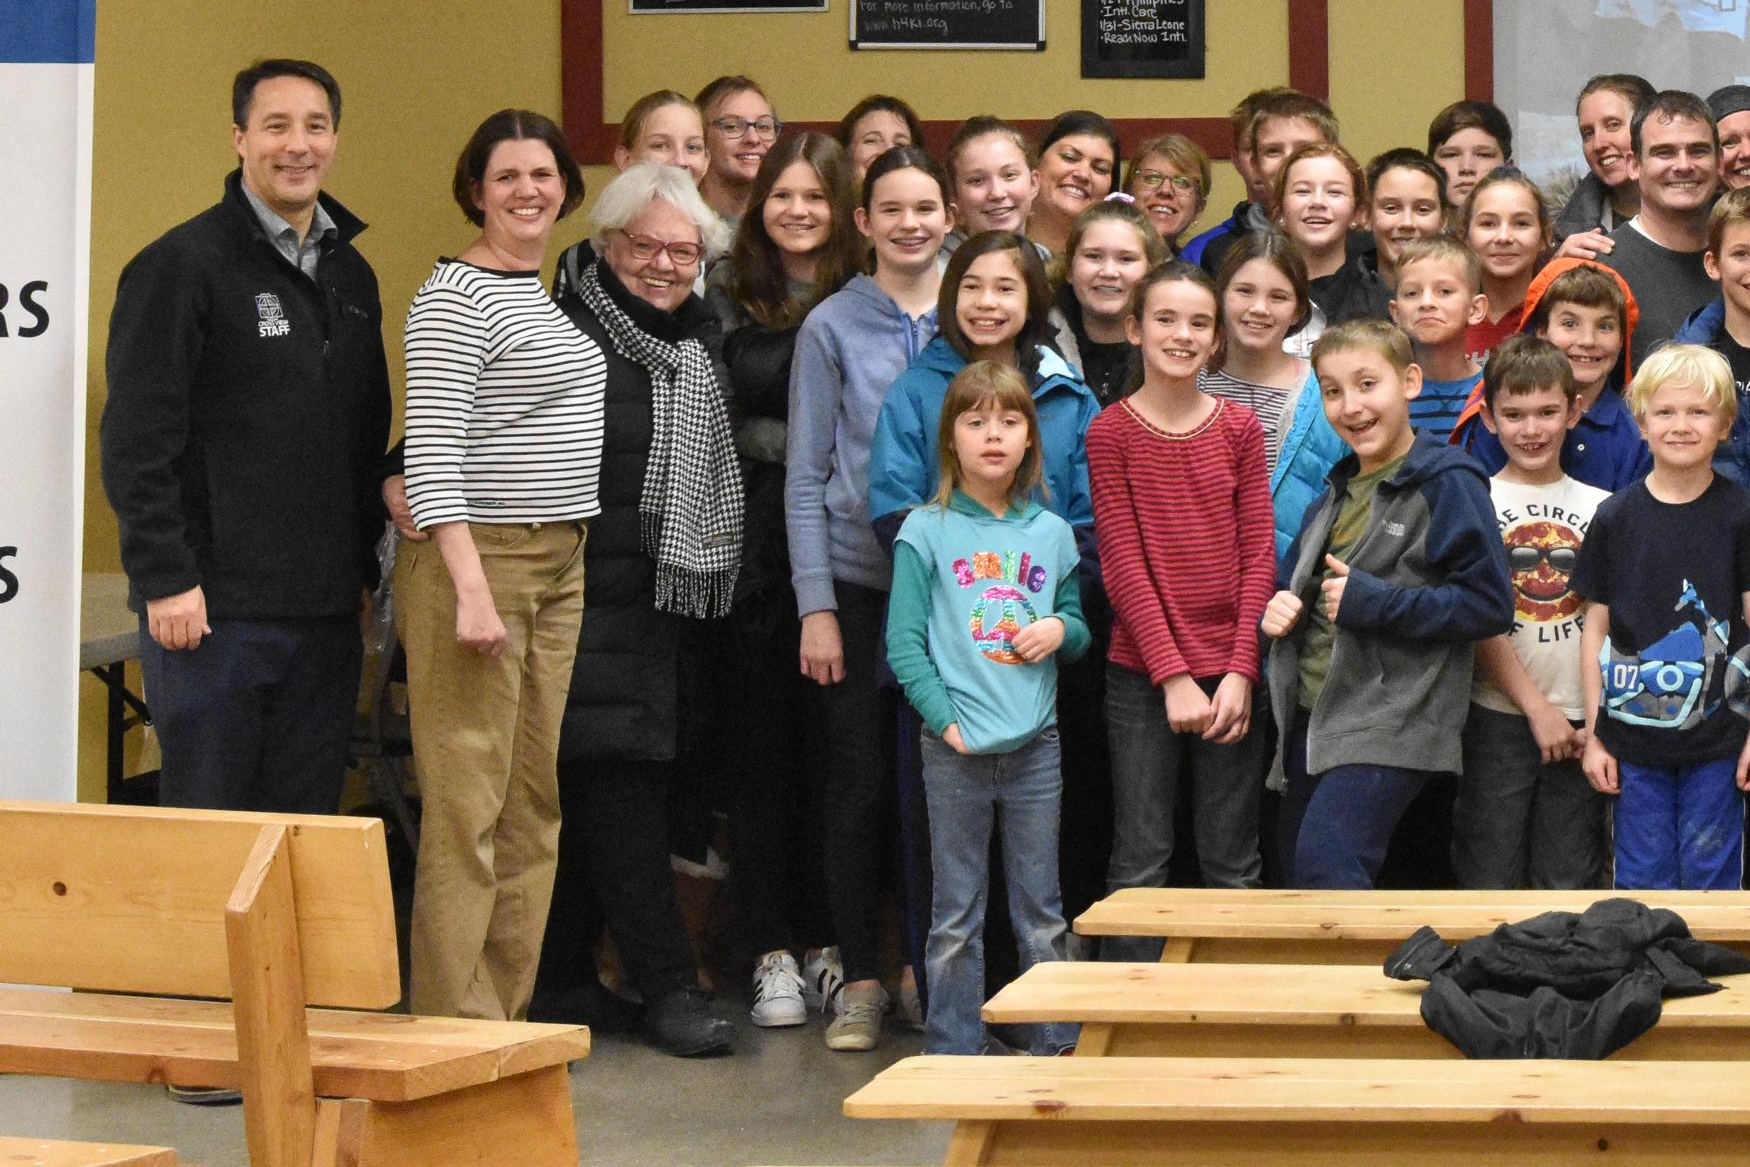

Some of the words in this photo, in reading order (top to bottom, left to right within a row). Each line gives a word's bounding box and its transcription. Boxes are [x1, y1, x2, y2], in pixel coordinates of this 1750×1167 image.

[884, 1, 909, 13] more
[982, 0, 996, 14] go
[1132, 6, 1158, 18] Care
[1156, 19, 1185, 30] Leone
[1133, 33, 1158, 43] Now
[259, 325, 290, 337] STAFF
[951, 550, 1047, 593] smile
[1614, 664, 1639, 690] 07
